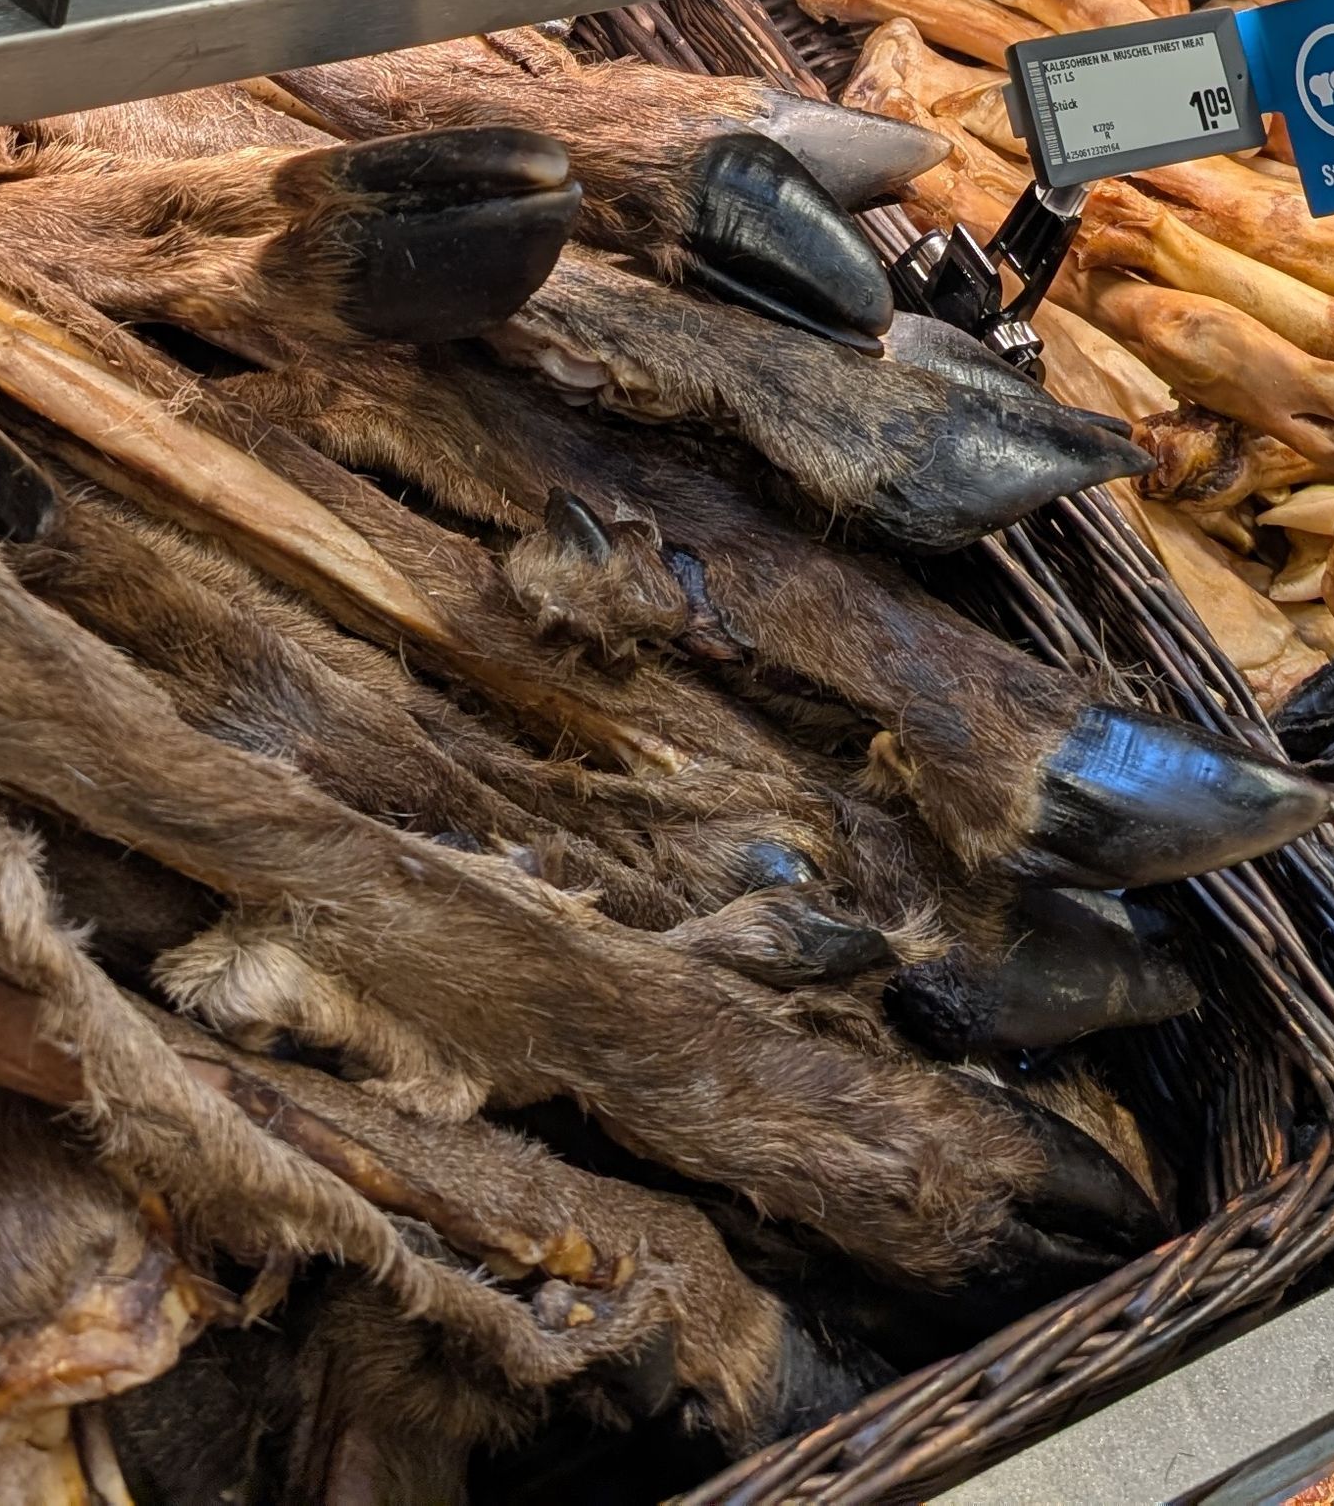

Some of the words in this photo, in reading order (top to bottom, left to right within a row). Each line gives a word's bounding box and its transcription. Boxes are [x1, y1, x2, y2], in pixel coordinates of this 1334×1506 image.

[1043, 55, 1099, 73] KALBSOHREN
[1113, 46, 1153, 61] MUSCHEL
[1153, 40, 1182, 54] FINEST
[1182, 36, 1205, 50] MEAT
[1064, 71, 1075, 83] LS
[1052, 98, 1078, 112] Stück
[1189, 86, 1233, 131] 1.09
